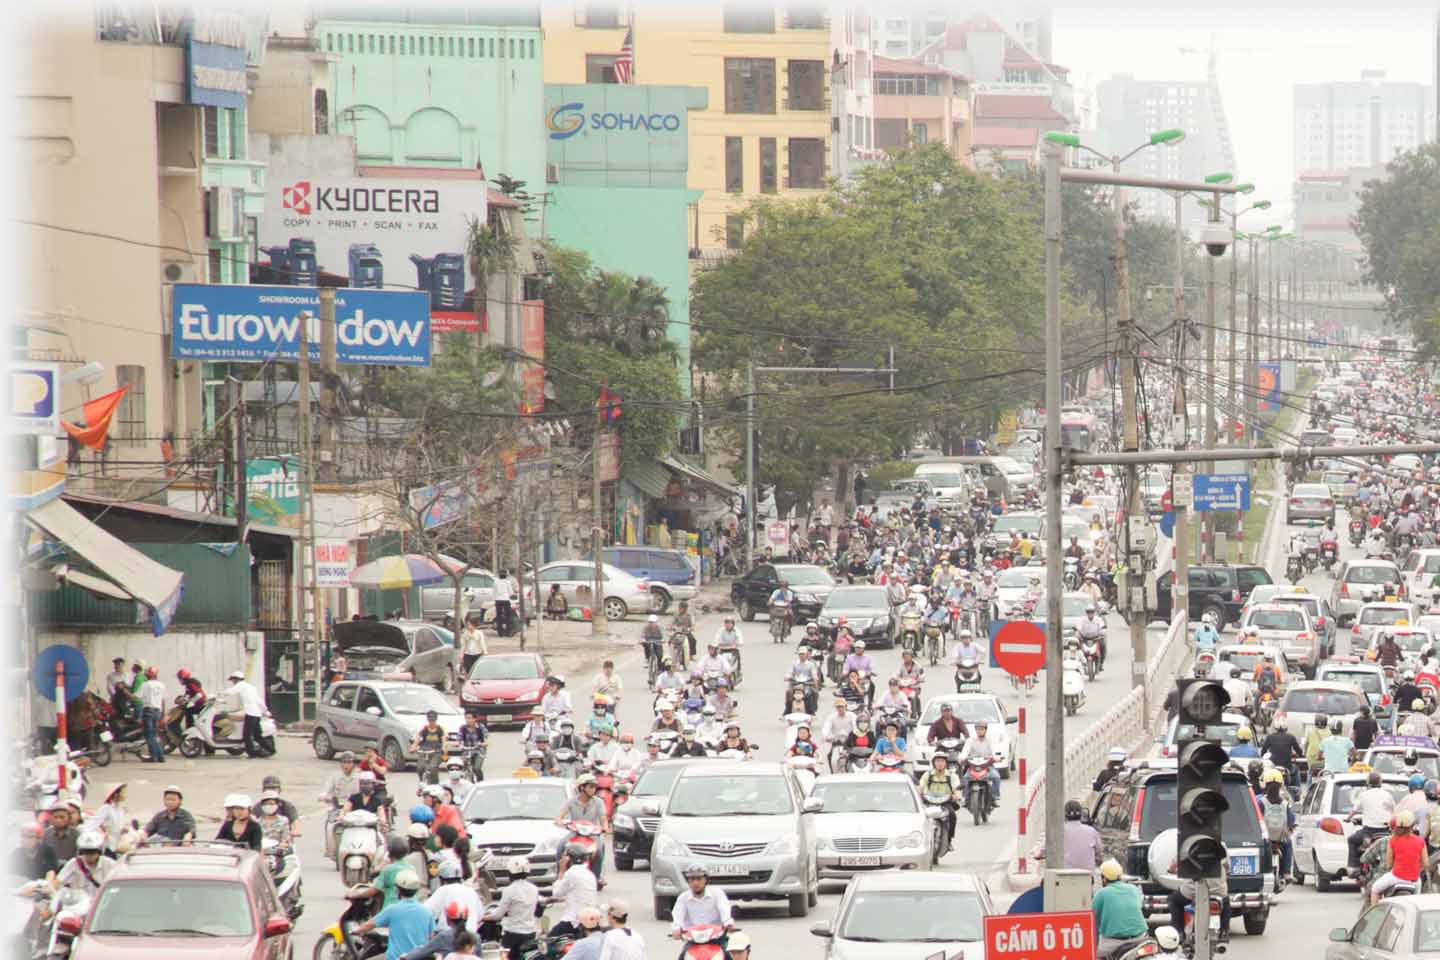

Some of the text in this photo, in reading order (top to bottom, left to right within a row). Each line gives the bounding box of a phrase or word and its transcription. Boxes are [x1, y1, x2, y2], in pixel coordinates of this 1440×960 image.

[591, 113, 680, 131] SOHACO
[284, 218, 438, 230] COPY PRINT SCAN FAX
[995, 922, 1084, 953] CẤM Ô TÔ
